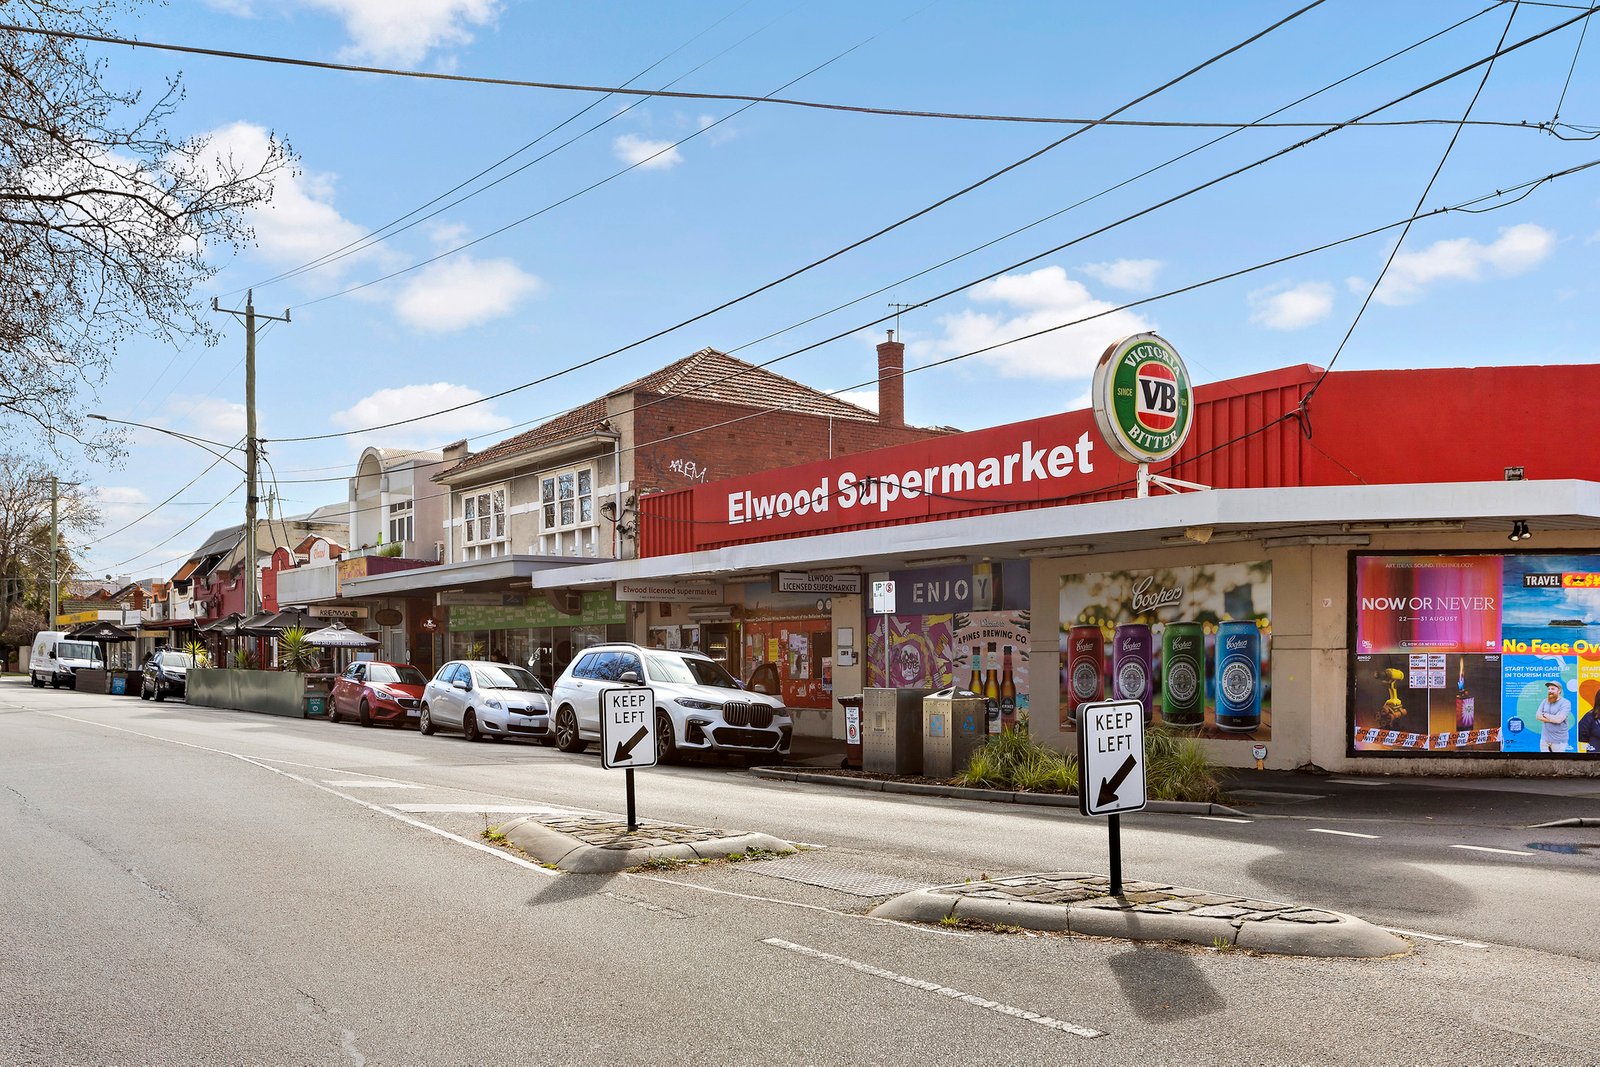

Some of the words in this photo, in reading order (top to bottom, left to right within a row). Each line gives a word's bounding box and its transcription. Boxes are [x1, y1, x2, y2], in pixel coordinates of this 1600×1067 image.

[1124, 345, 1180, 377] VICTORIA
[1117, 388, 1133, 397] SINCE
[1138, 378, 1177, 413] VB
[1128, 423, 1178, 449] BITTER
[728, 476, 829, 525] Elwood
[837, 431, 1094, 512] Supermarket
[808, 575, 834, 583] ELWOOD
[1526, 575, 1560, 586] TRAVEL
[623, 585, 647, 593] Elwood
[648, 586, 676, 595] licensed
[677, 587, 717, 596] supermarket
[783, 583, 812, 591] LICENSED
[813, 583, 857, 592] SUPERMARKET
[913, 578, 988, 603] ENJOY
[1132, 575, 1183, 612] Coopers
[1362, 597, 1407, 611] NOW
[1408, 597, 1433, 611] OR
[1436, 597, 1496, 611] NEVER
[962, 631, 981, 644] PINES
[982, 629, 1013, 640] BREWING
[1015, 633, 1028, 645] CO.
[1503, 639, 1528, 654] No
[1532, 639, 1570, 654] Fees
[613, 695, 646, 708] KEEP
[615, 711, 645, 724] LEFT
[1096, 712, 1133, 731] KEEP
[1378, 730, 1395, 738] LOAD
[1396, 732, 1414, 740] YOUR
[1449, 732, 1466, 740] LOAD
[1467, 730, 1486, 738] YOUR
[1098, 734, 1132, 753] LEFT
